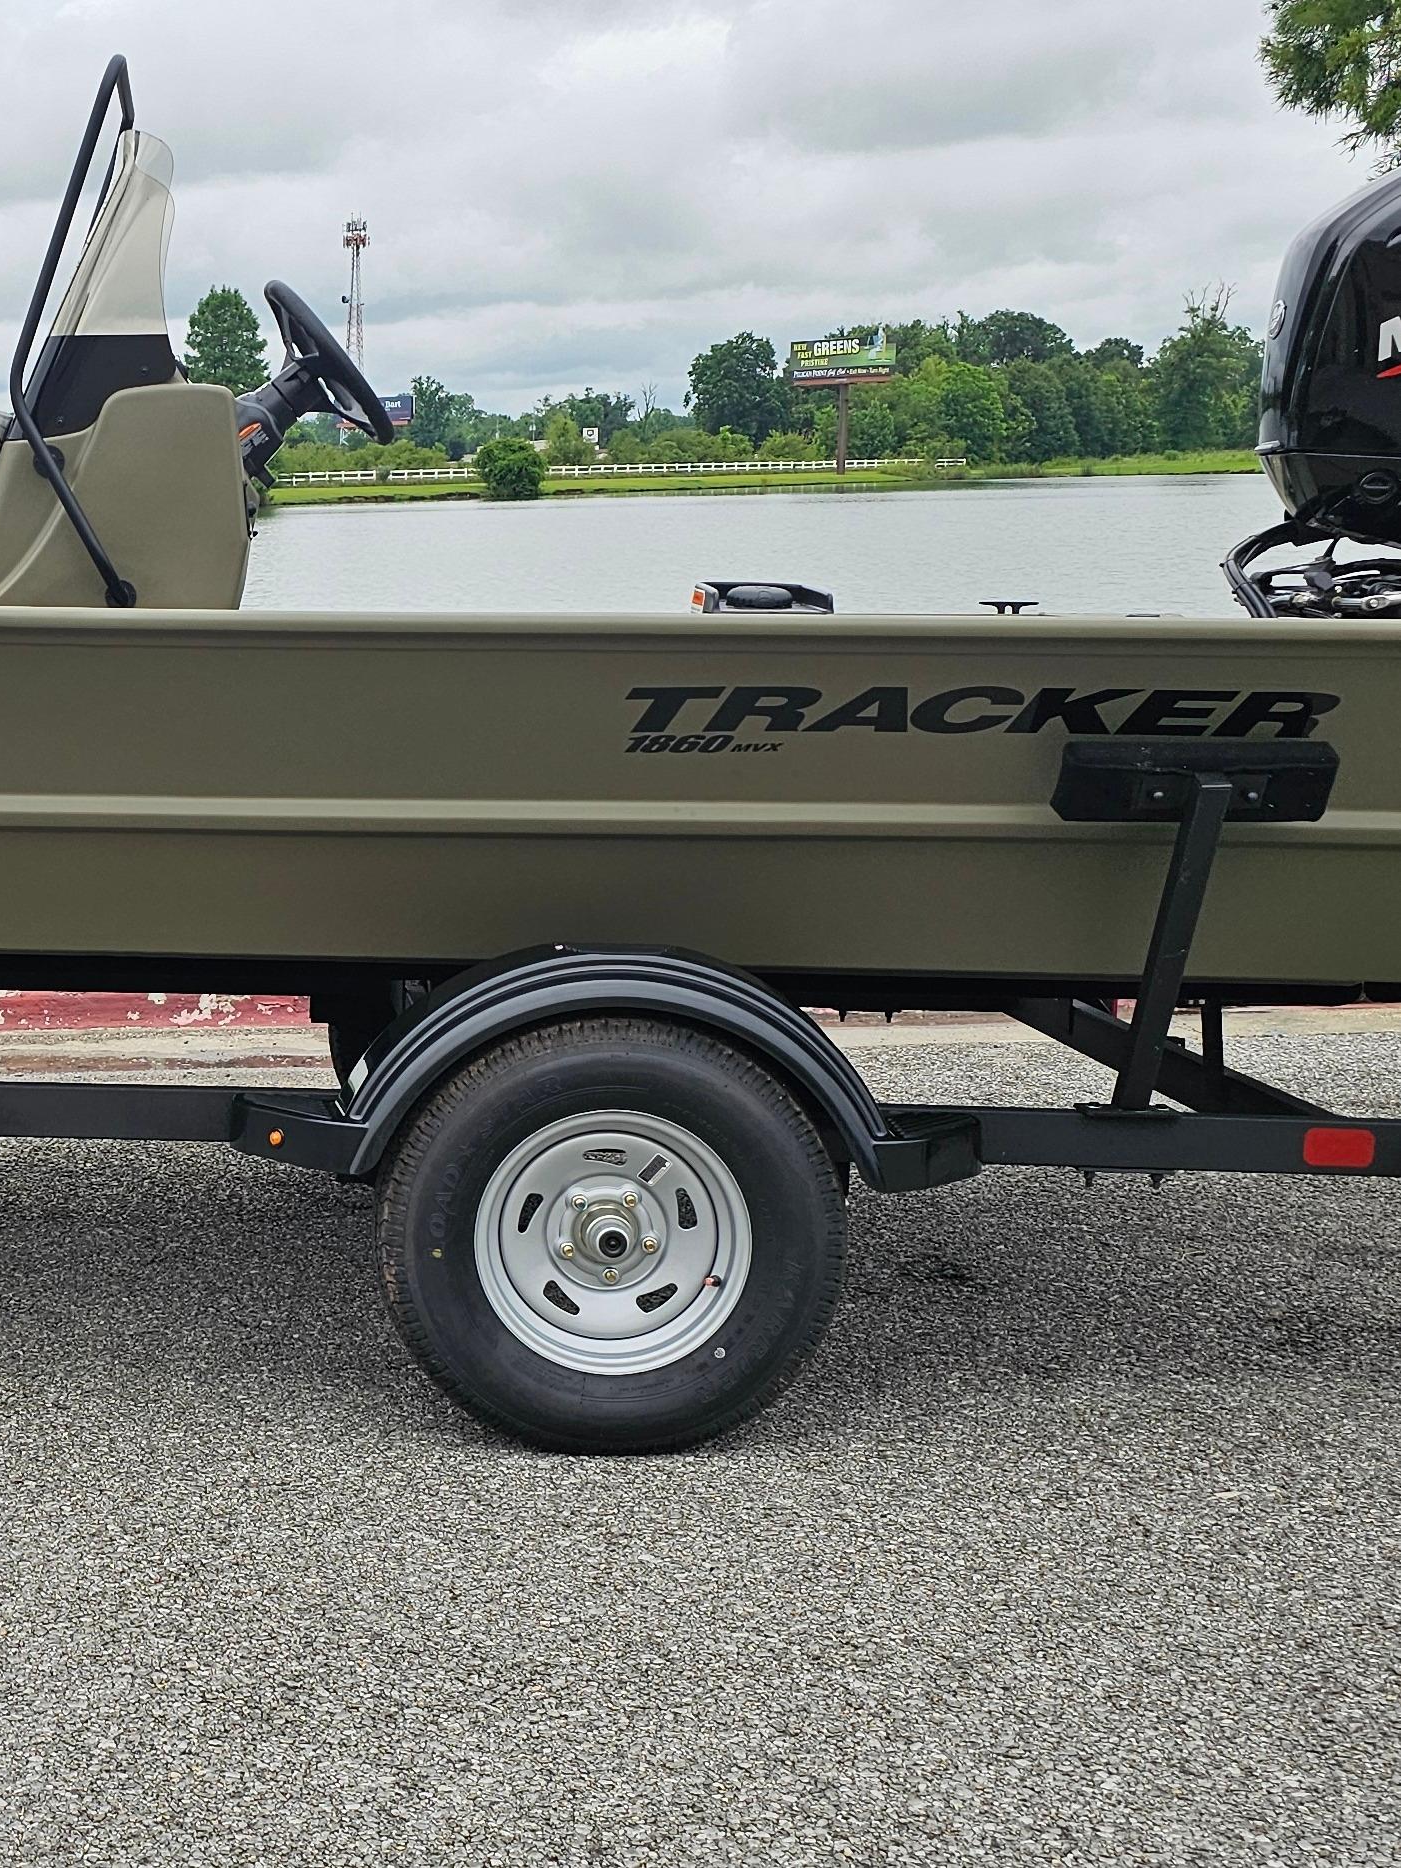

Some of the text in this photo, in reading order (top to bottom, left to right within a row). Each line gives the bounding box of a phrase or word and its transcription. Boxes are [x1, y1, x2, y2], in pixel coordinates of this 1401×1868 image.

[797, 351, 812, 359] FAST
[813, 338, 860, 357] GREENS
[624, 686, 1341, 738] TRACKER
[624, 734, 785, 753] 1860 MVX
